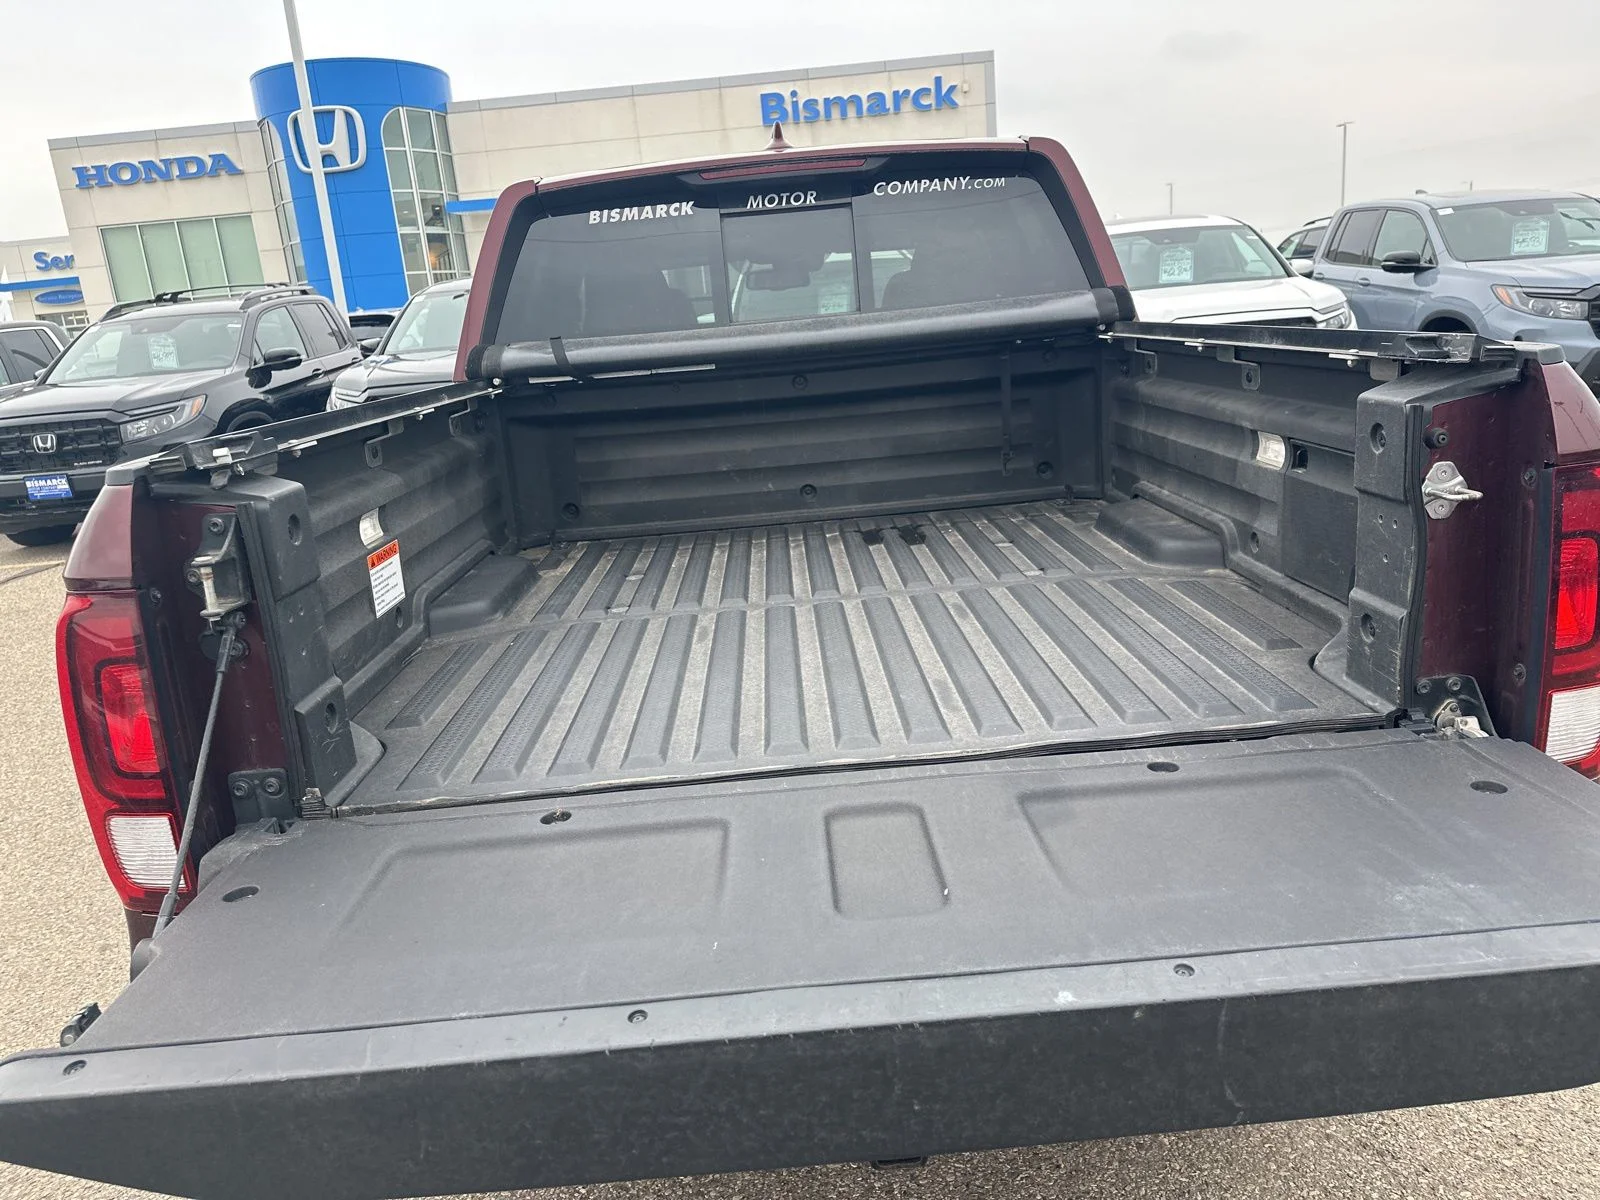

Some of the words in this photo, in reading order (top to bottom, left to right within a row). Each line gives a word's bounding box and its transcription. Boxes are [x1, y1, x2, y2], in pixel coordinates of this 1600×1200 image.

[760, 75, 959, 127] Bismarck
[72, 153, 244, 189] HONDA
[746, 190, 817, 210] MOTOR
[588, 200, 695, 225] BISMARCK
[25, 479, 67, 489] BISMARCK
[375, 543, 397, 564] WARNING
